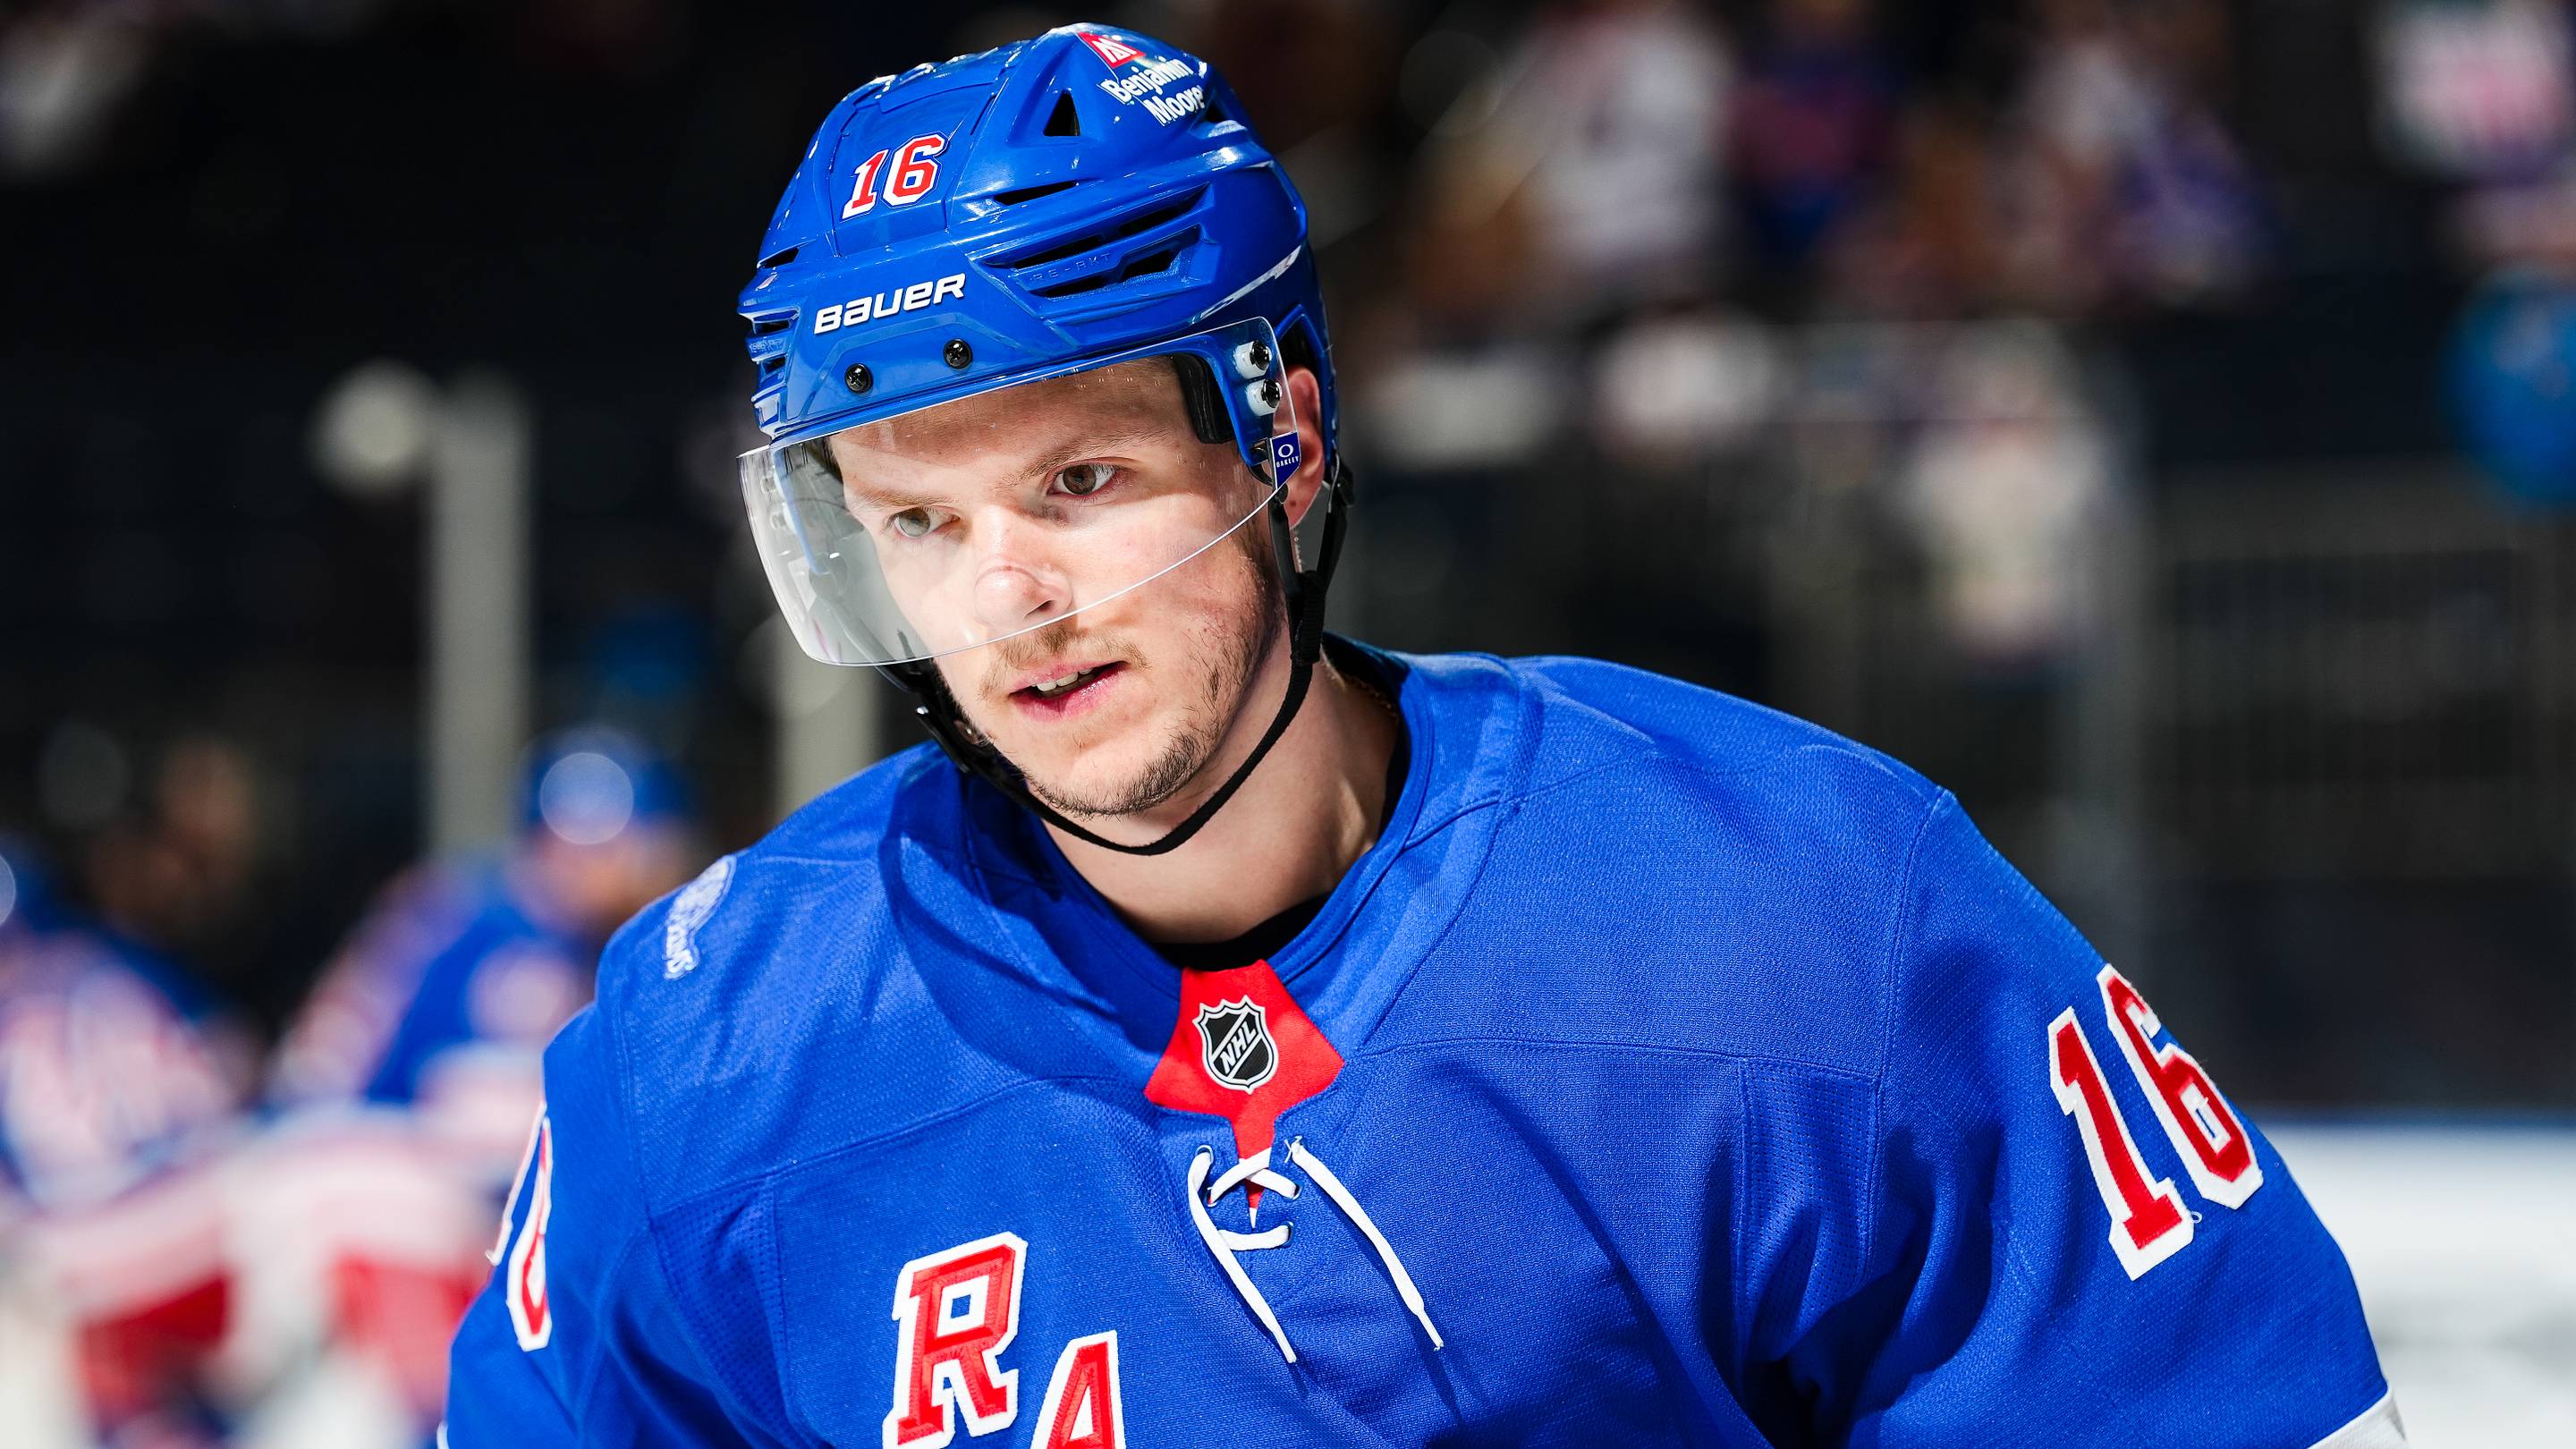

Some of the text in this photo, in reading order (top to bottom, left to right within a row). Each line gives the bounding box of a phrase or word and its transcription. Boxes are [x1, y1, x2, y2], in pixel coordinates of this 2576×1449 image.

[1101, 58, 1194, 103] Benjamin
[1143, 87, 1205, 123] Moore
[842, 134, 945, 219] 16
[1275, 456, 1300, 468] OAKLEY
[1219, 1021, 1257, 1074] NHL
[2047, 963, 2264, 1281] 16
